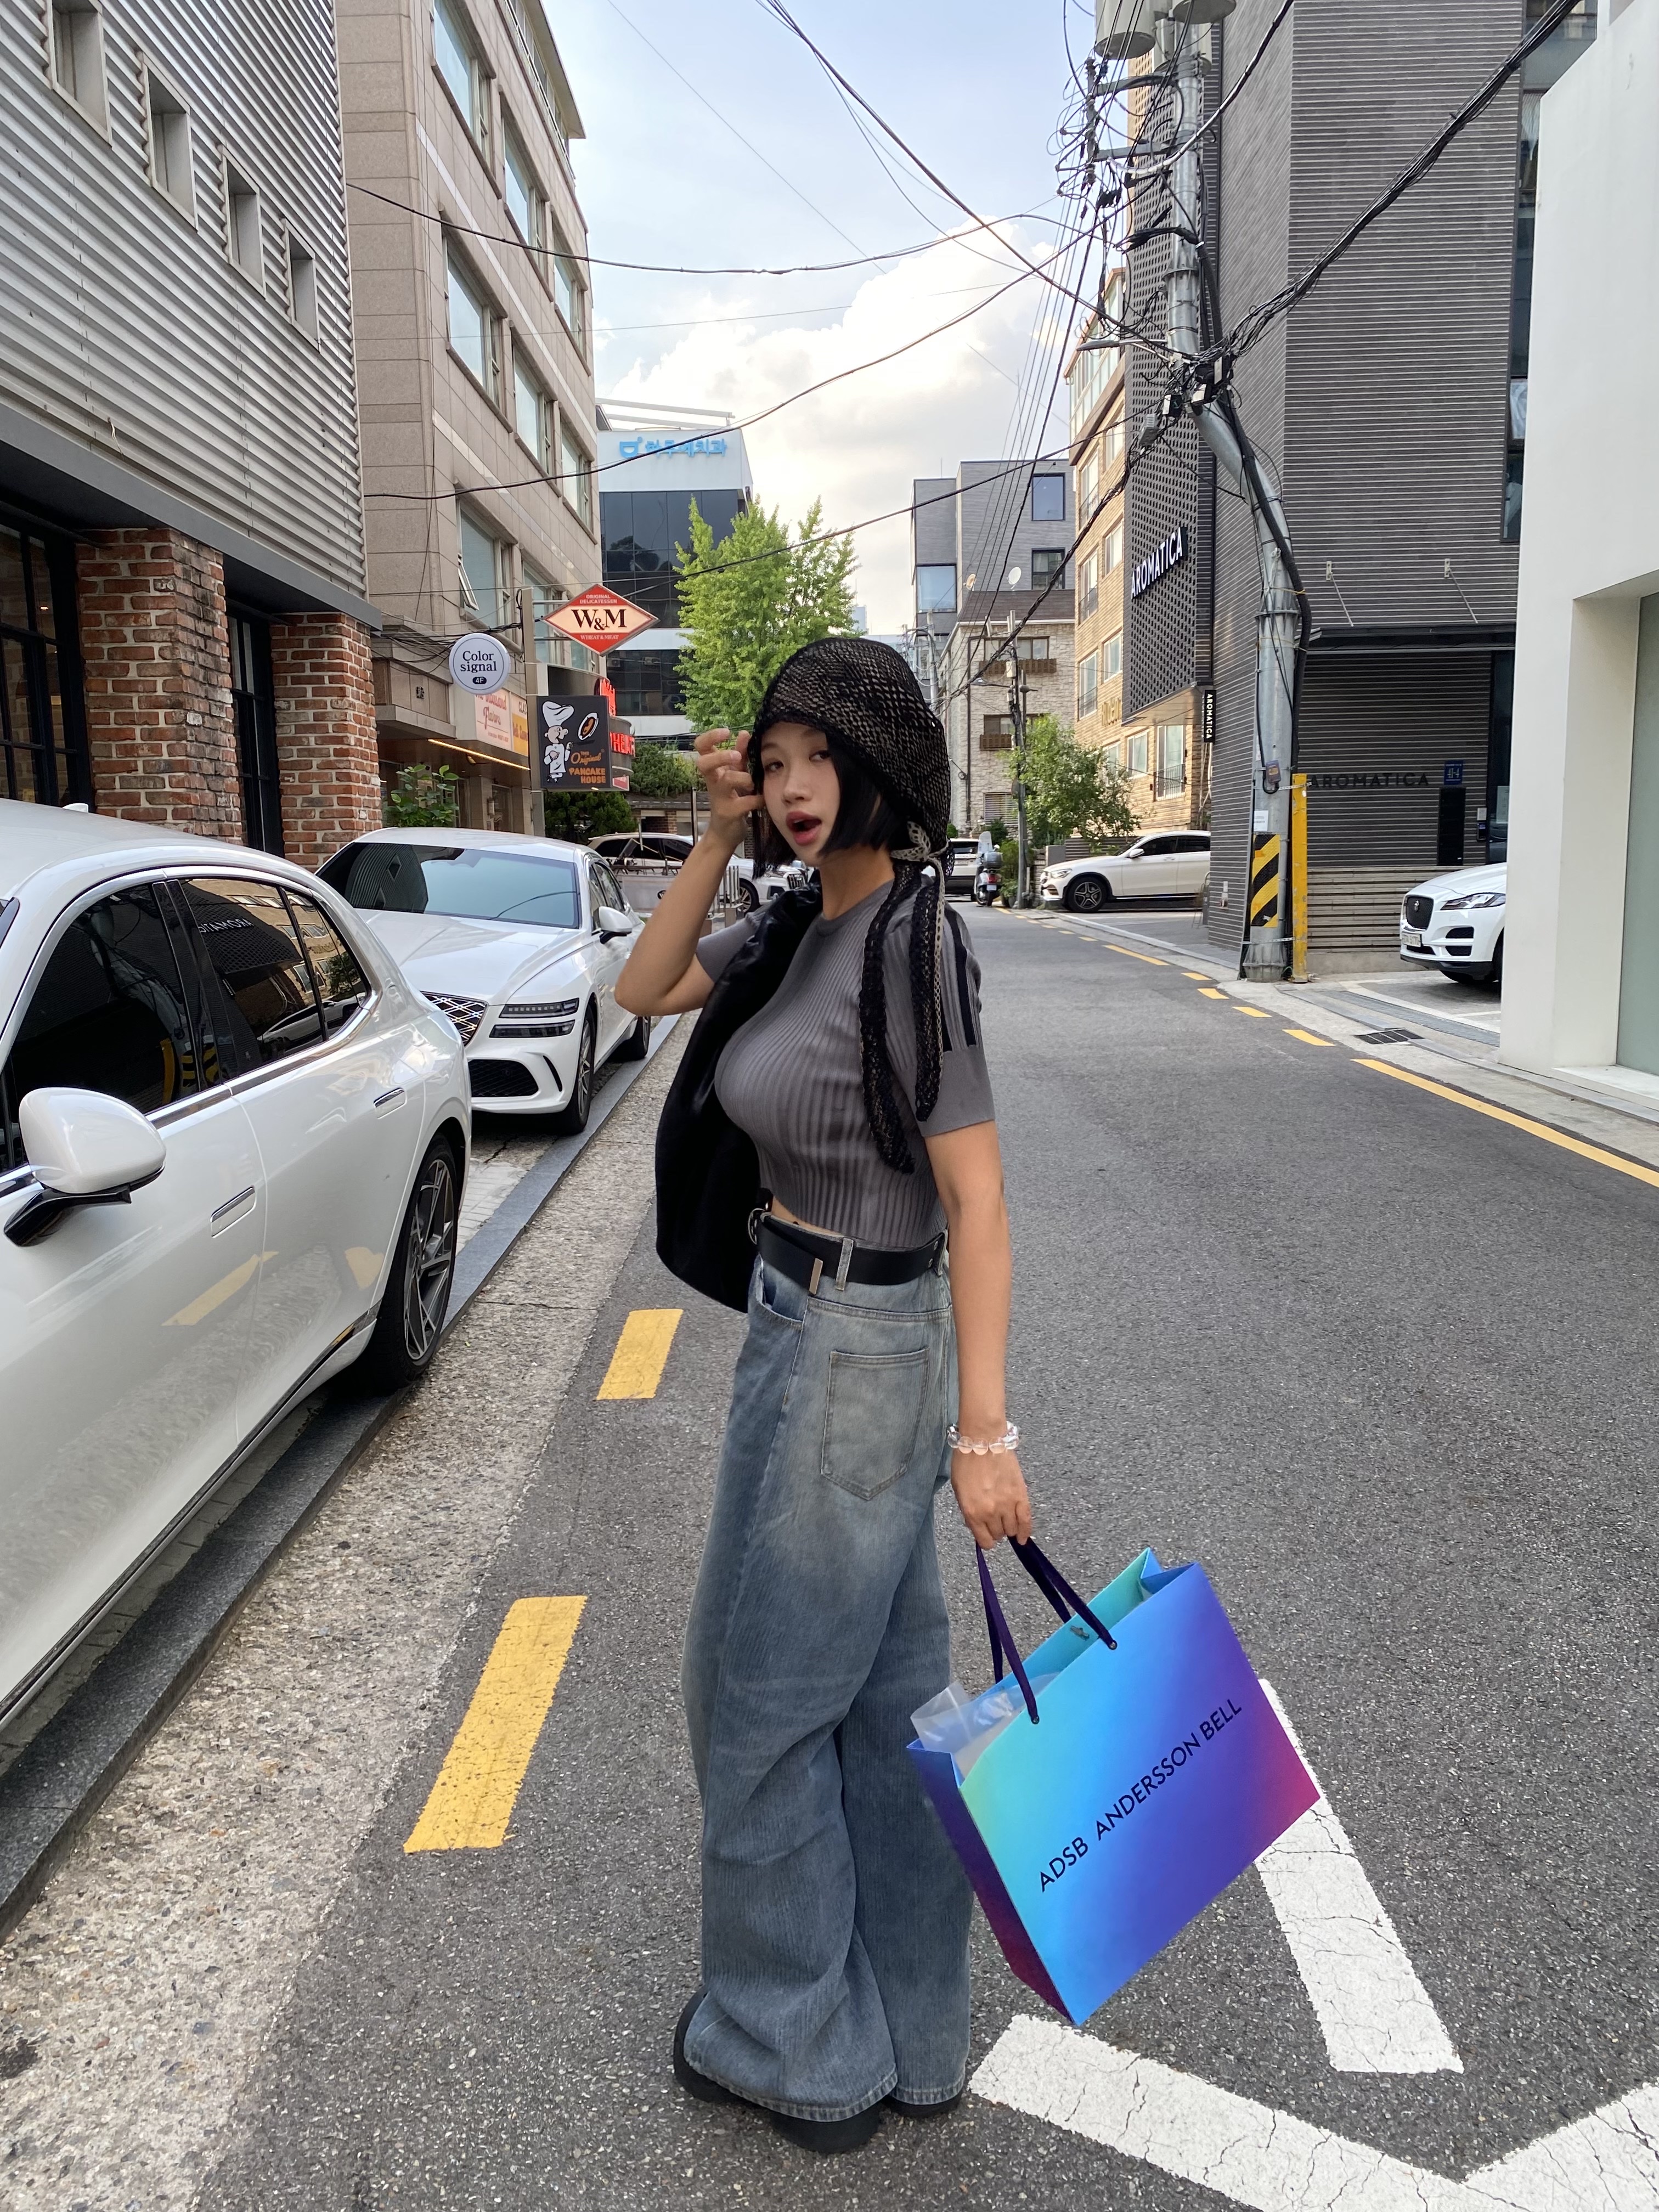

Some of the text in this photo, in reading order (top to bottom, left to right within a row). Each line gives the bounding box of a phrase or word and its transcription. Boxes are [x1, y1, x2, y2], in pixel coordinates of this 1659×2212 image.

[1131, 527, 1182, 600] AROMATICA
[571, 609, 627, 630] W&M
[462, 651, 494, 661] Color
[460, 661, 497, 673] signal
[571, 752, 602, 765] Original
[1312, 772, 1429, 788] AROMATICA
[1040, 1699, 1242, 1893] ADSB ANDERSSON BELL
